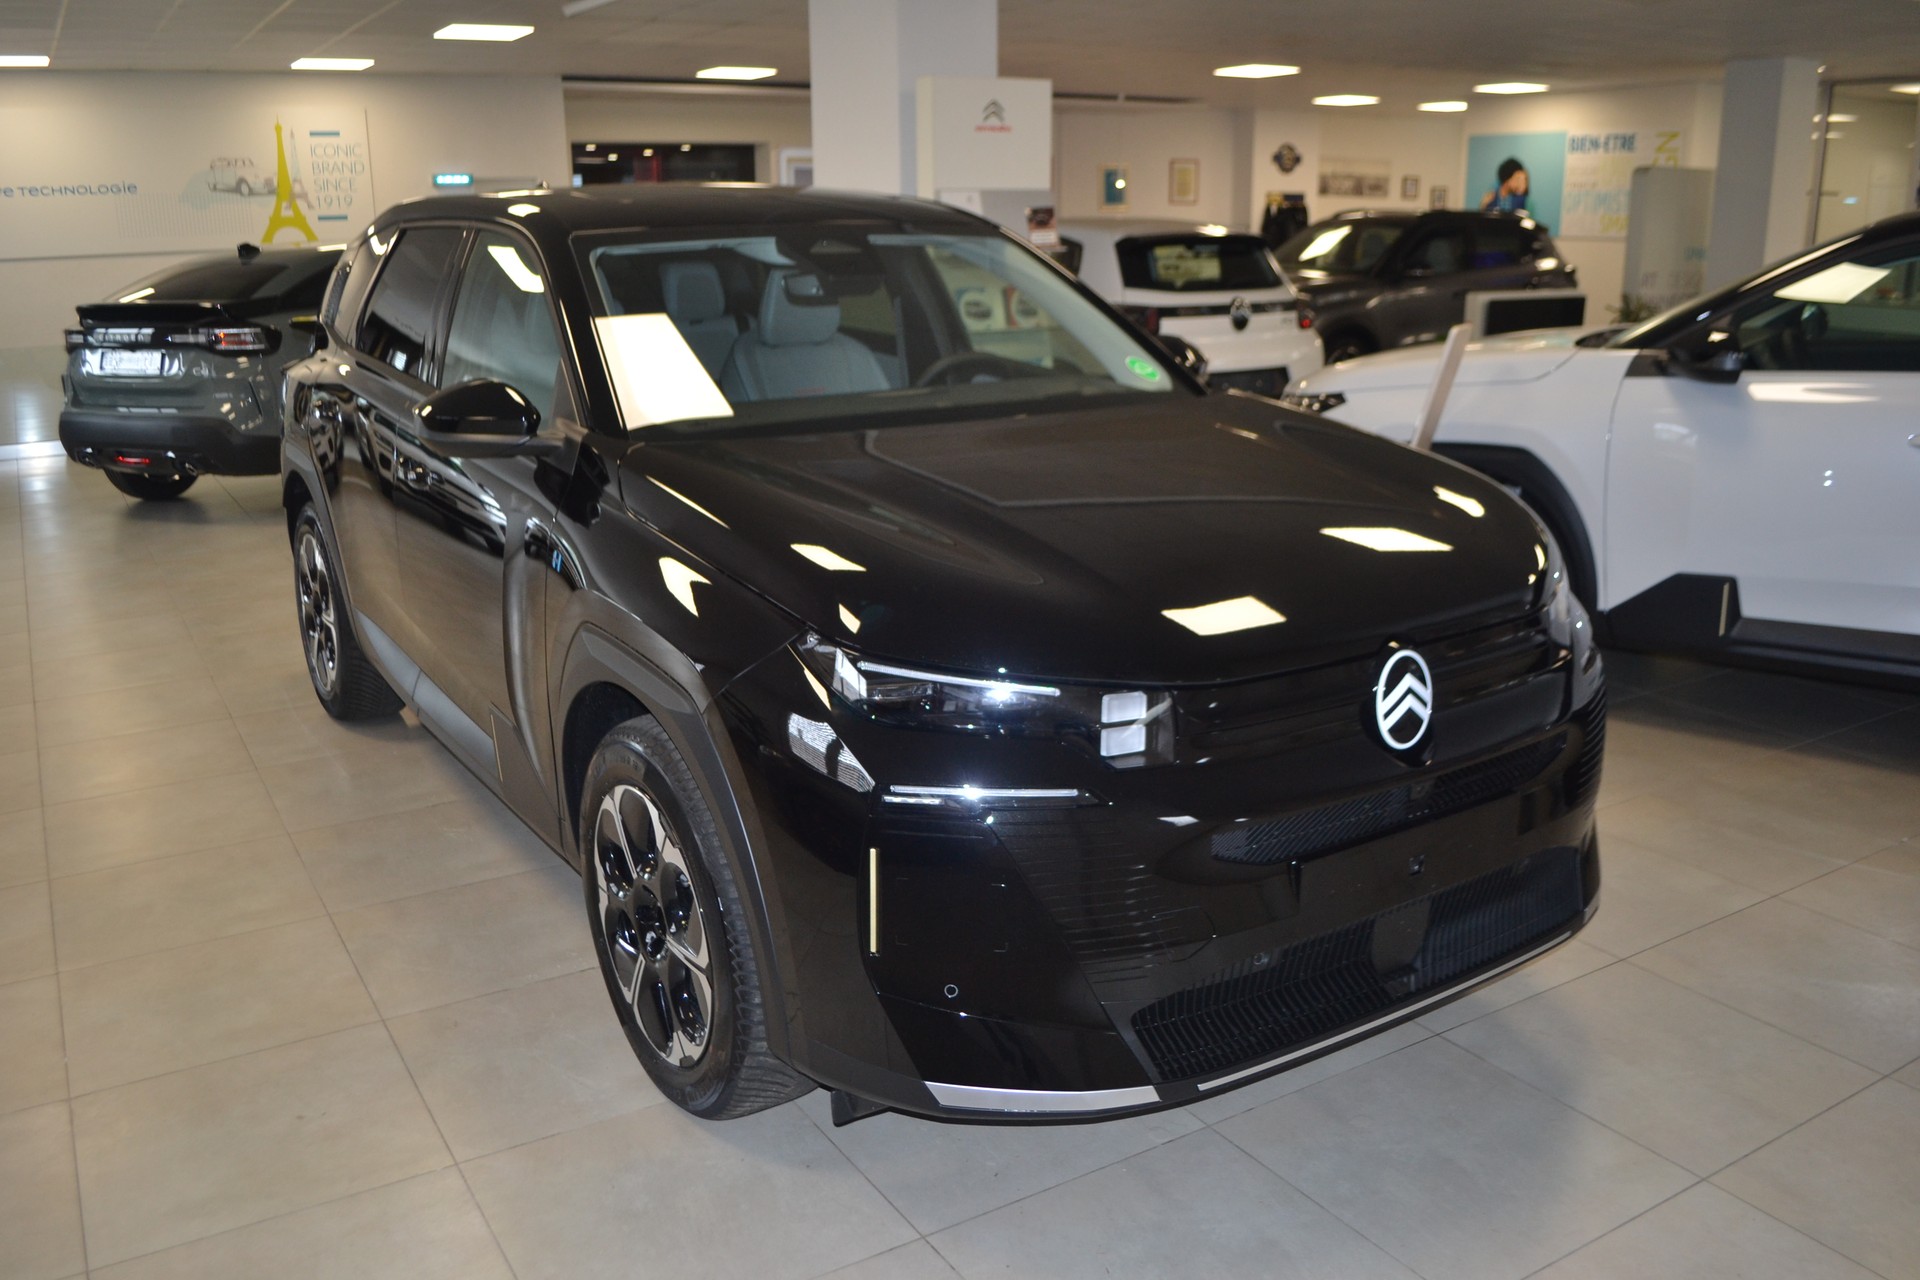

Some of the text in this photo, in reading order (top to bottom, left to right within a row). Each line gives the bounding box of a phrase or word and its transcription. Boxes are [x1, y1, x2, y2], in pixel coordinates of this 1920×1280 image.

[310, 143, 362, 159] ICONIC
[312, 160, 365, 176] BRAND
[313, 177, 358, 194] SINCE
[317, 194, 353, 209] 1919
